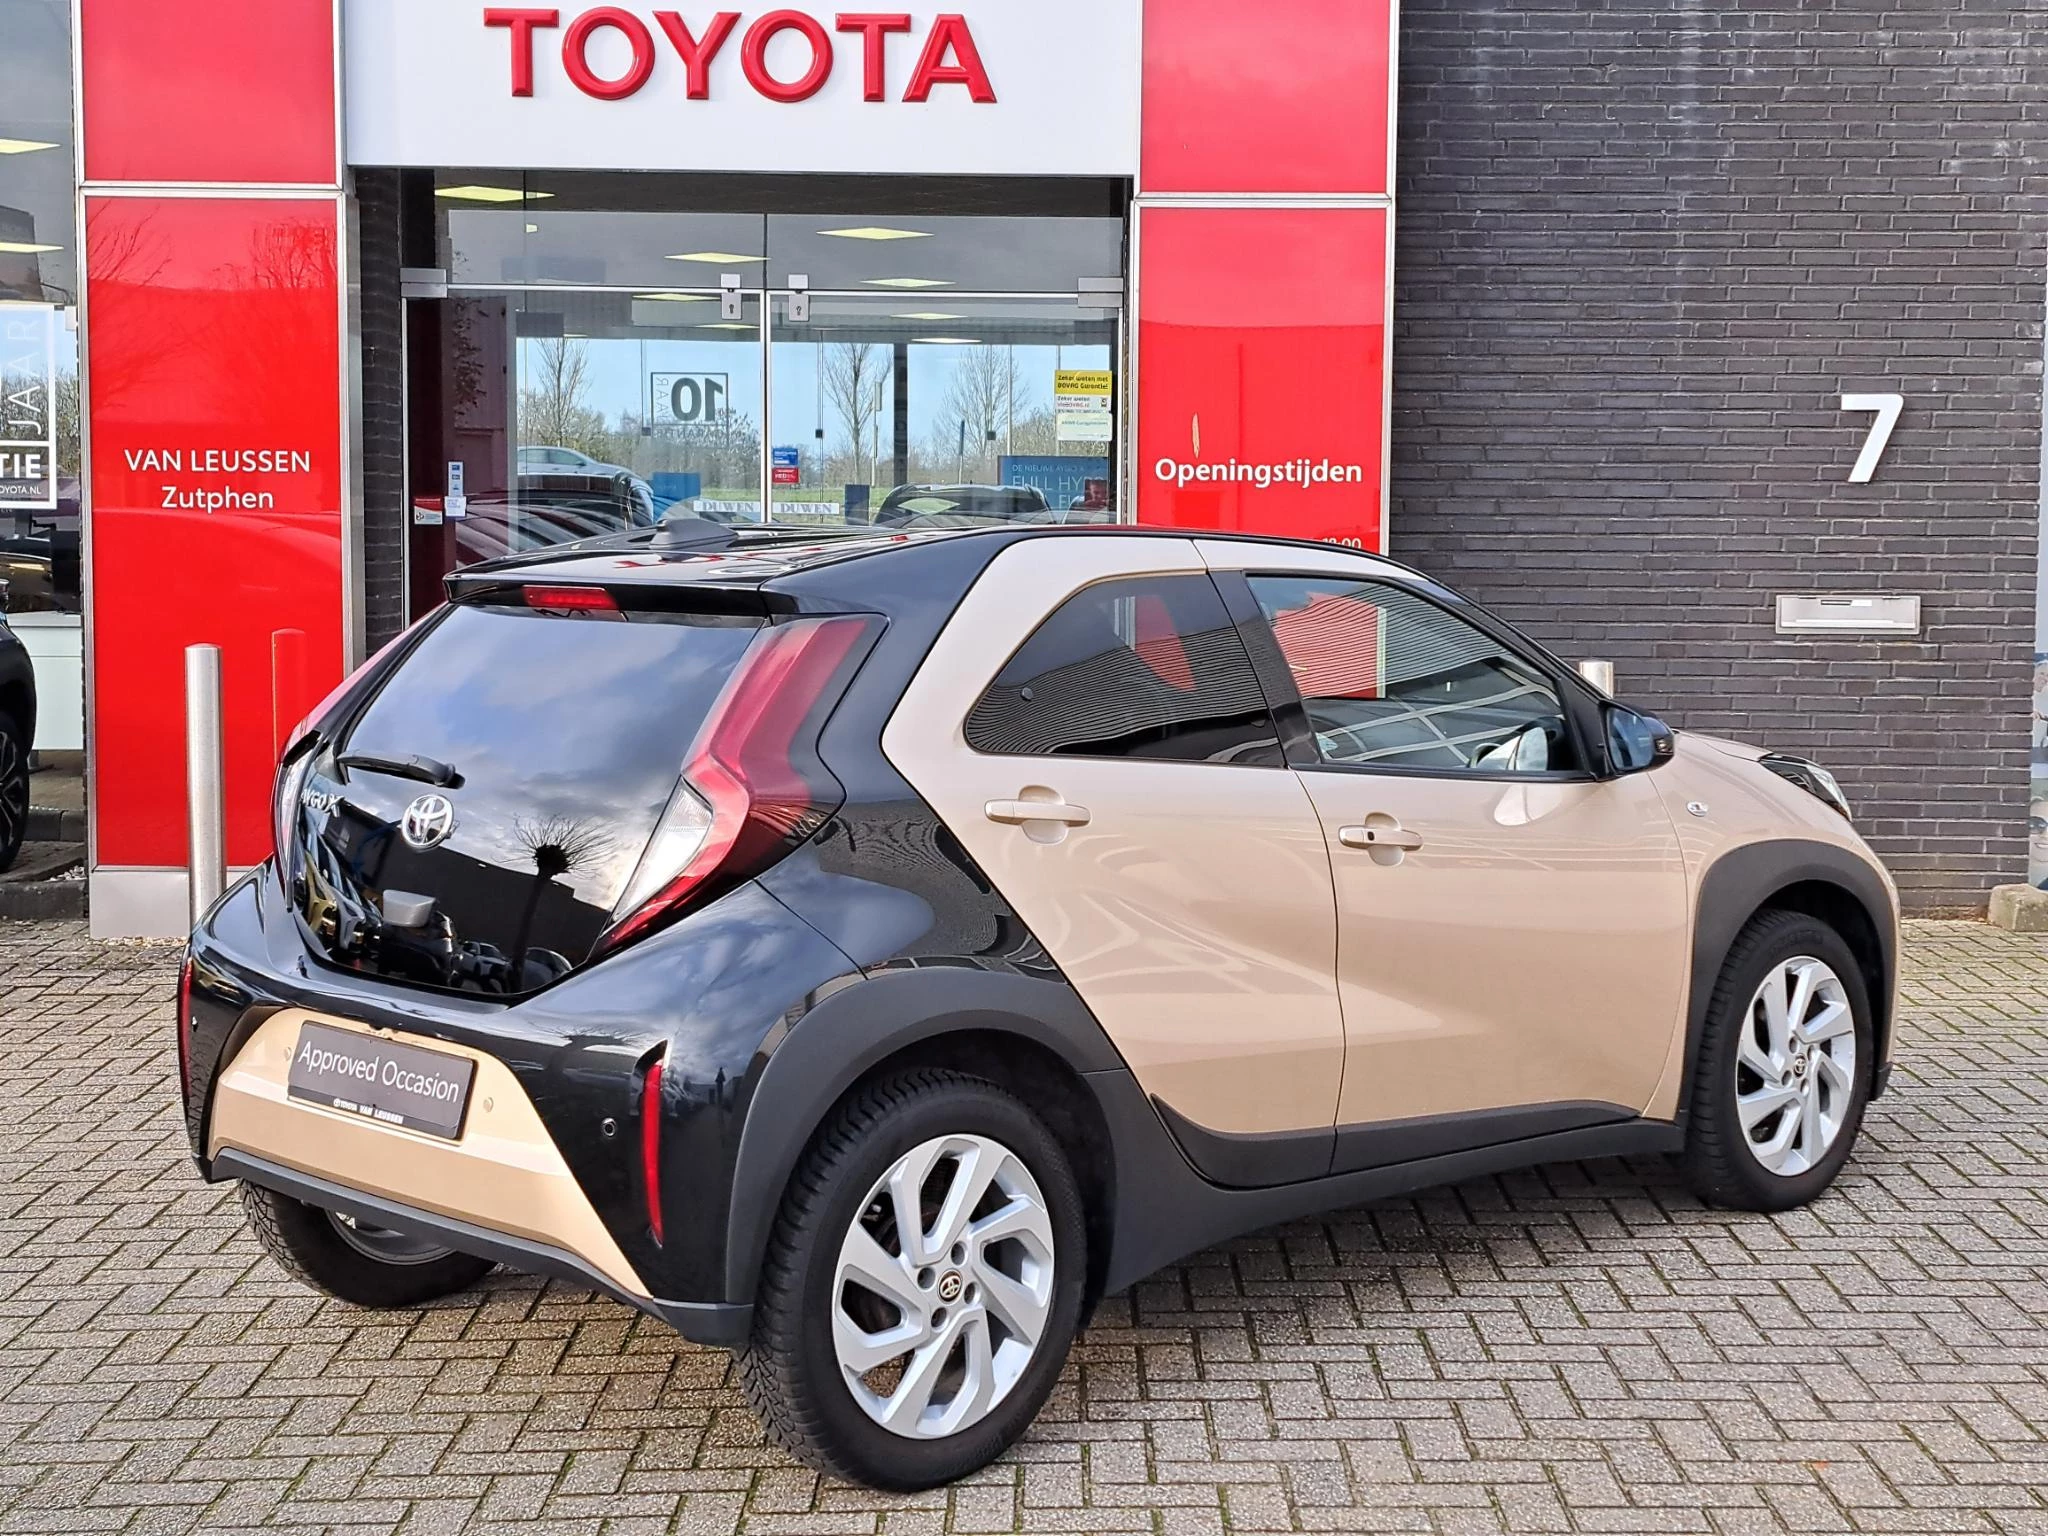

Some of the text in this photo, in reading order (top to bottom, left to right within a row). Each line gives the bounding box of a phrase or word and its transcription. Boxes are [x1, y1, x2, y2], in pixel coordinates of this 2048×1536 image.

[483, 6, 998, 103] TOYOTA
[7, 320, 42, 435] JAAR
[1840, 393, 1904, 483] 7
[124, 449, 311, 473] VAN LEUSSEN
[1155, 458, 1363, 489] Openingstijden
[1058, 475, 1105, 491] HY
[161, 485, 274, 514] Zutphen
[702, 501, 754, 512] DUWEN
[780, 503, 833, 514] DUWEN
[298, 1041, 460, 1104] Approved Occasion
